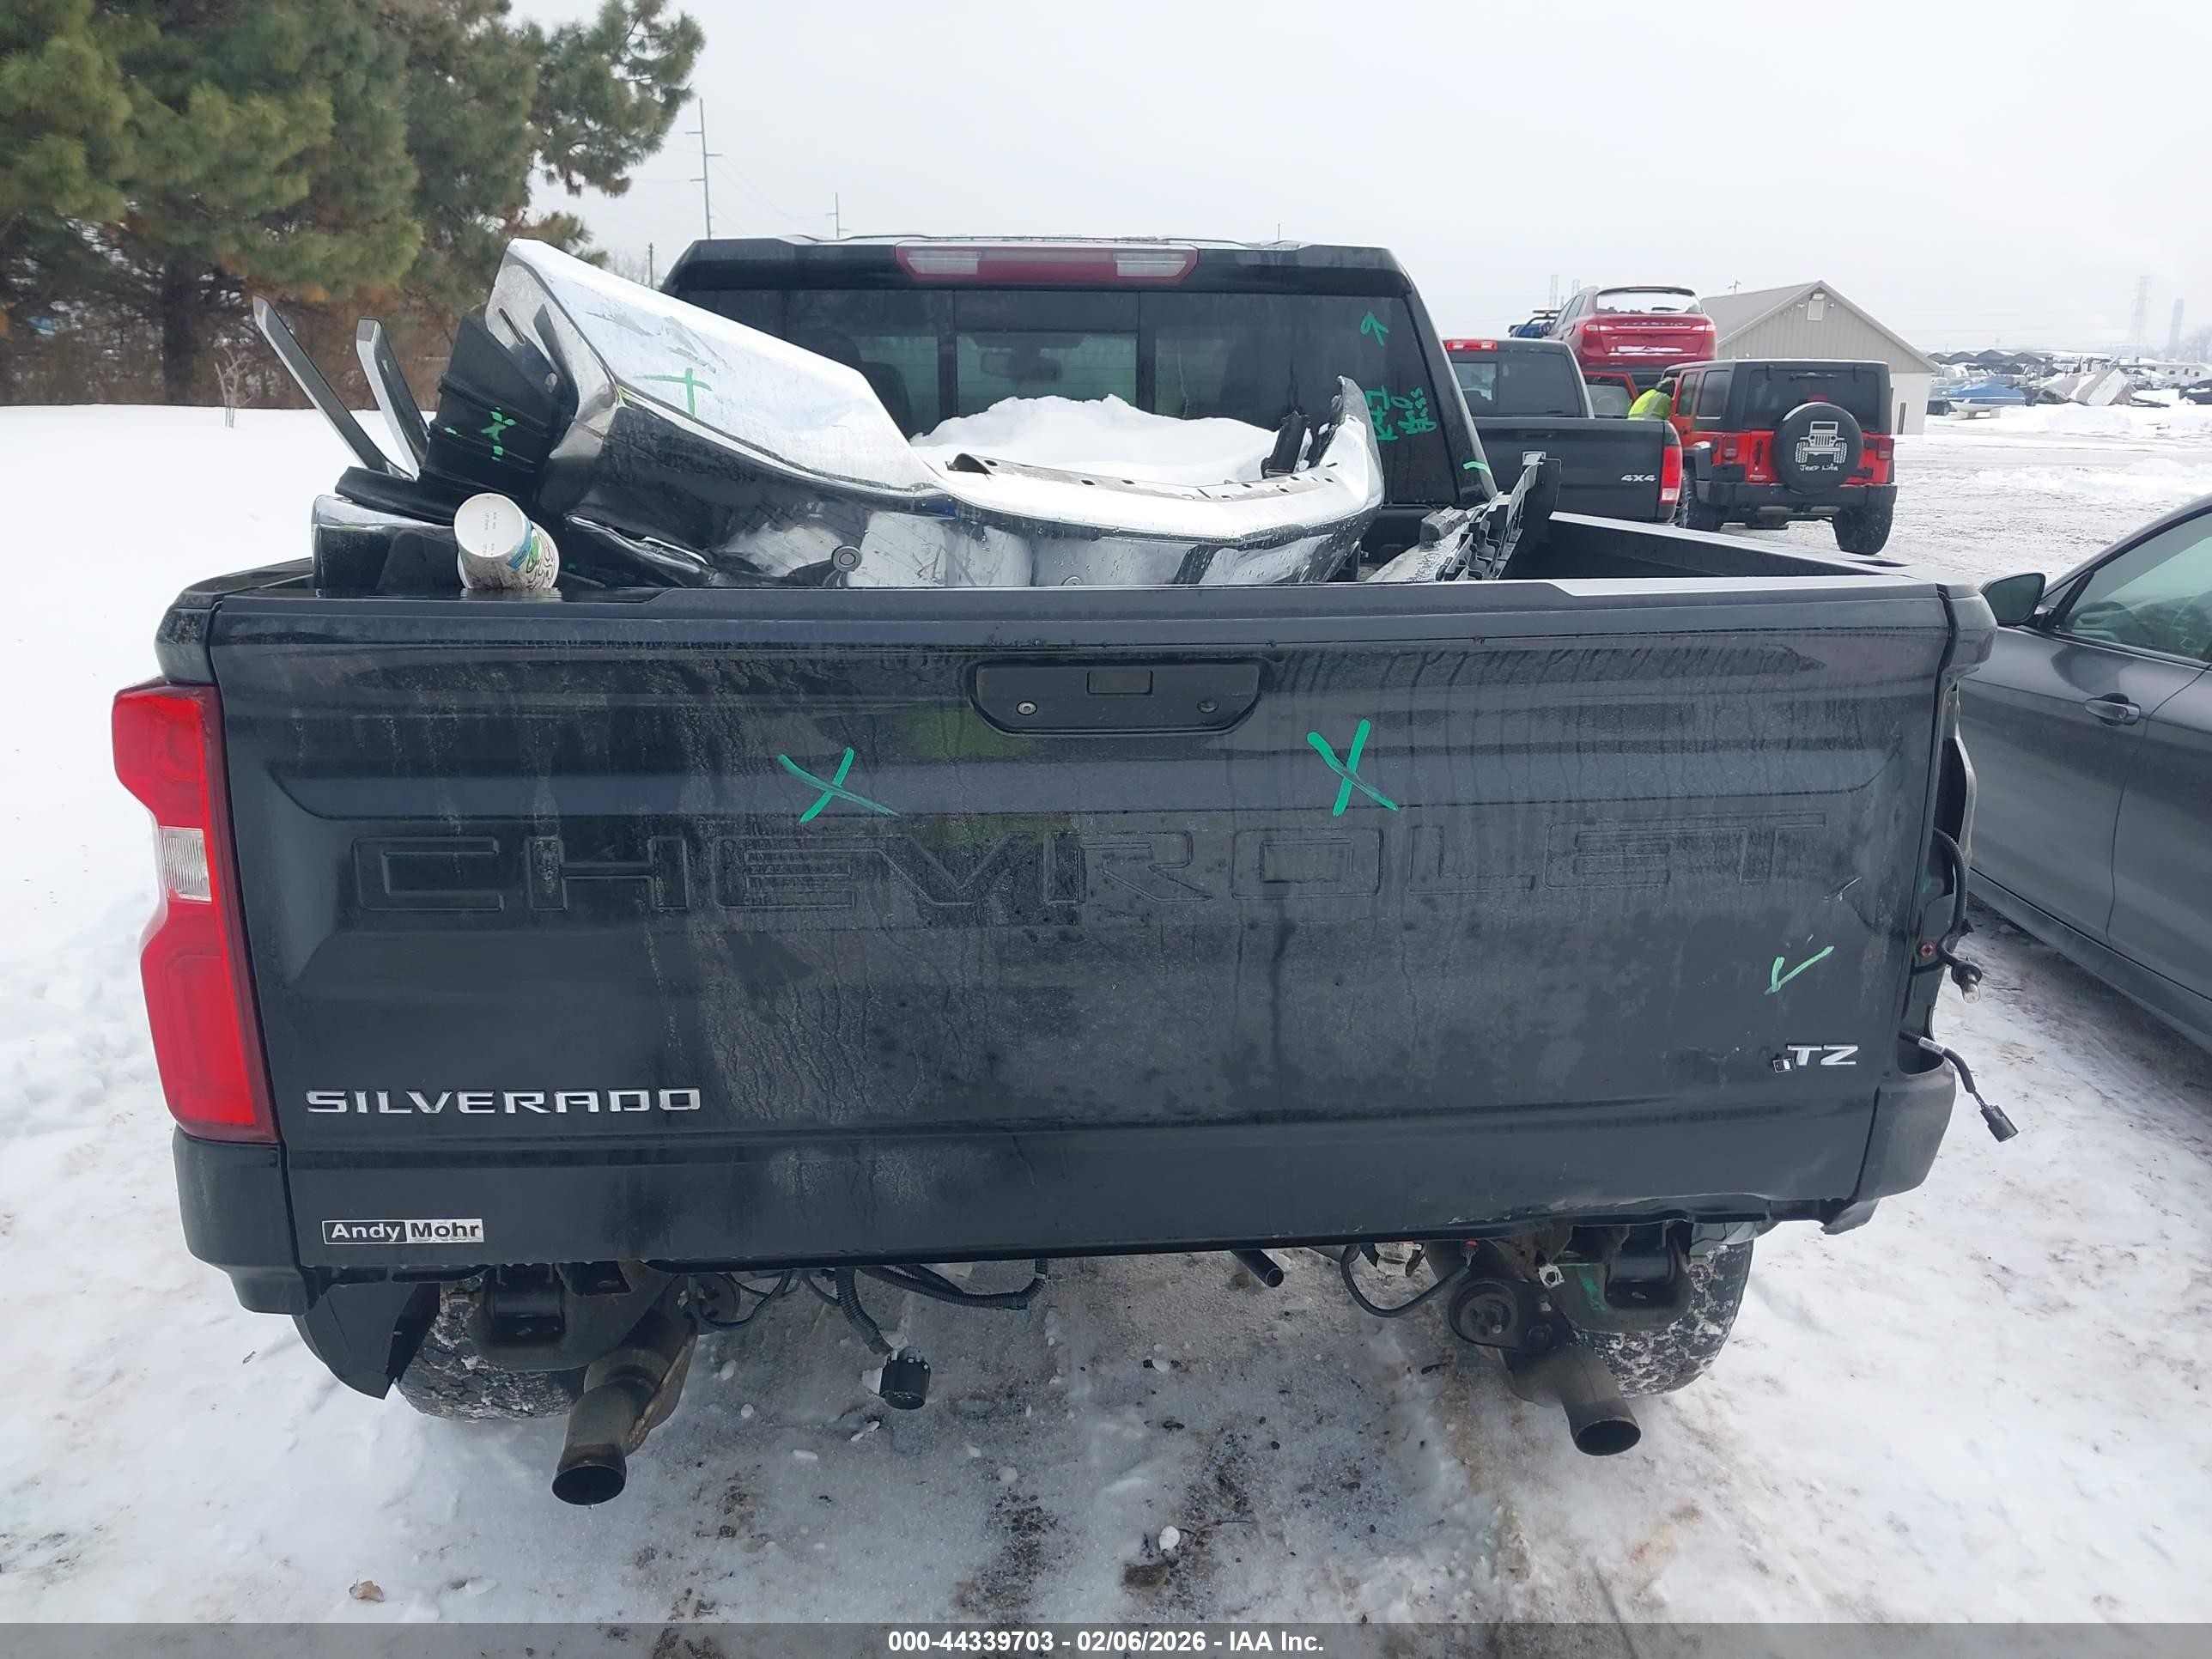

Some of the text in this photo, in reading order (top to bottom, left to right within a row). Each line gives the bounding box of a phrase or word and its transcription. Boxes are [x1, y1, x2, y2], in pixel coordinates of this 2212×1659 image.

[353, 811, 1827, 914] CHEVROLET
[306, 1088, 702, 1114] SILVERADO
[331, 1221, 480, 1242] Andy Mohr
